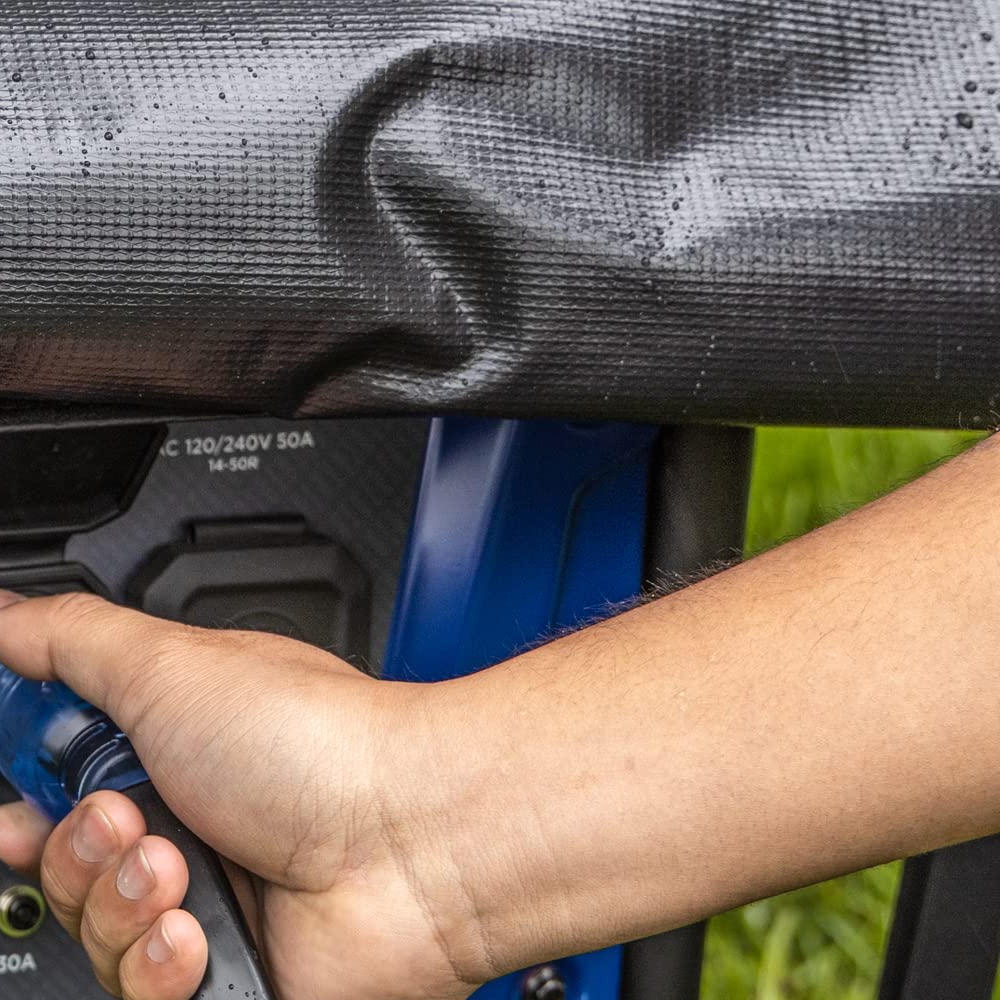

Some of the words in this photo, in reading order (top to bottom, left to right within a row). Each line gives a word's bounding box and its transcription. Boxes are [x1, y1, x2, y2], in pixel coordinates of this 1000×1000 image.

[185, 433, 272, 456] 120/240V
[277, 431, 314, 449] 50A
[208, 456, 259, 472] 14-50R
